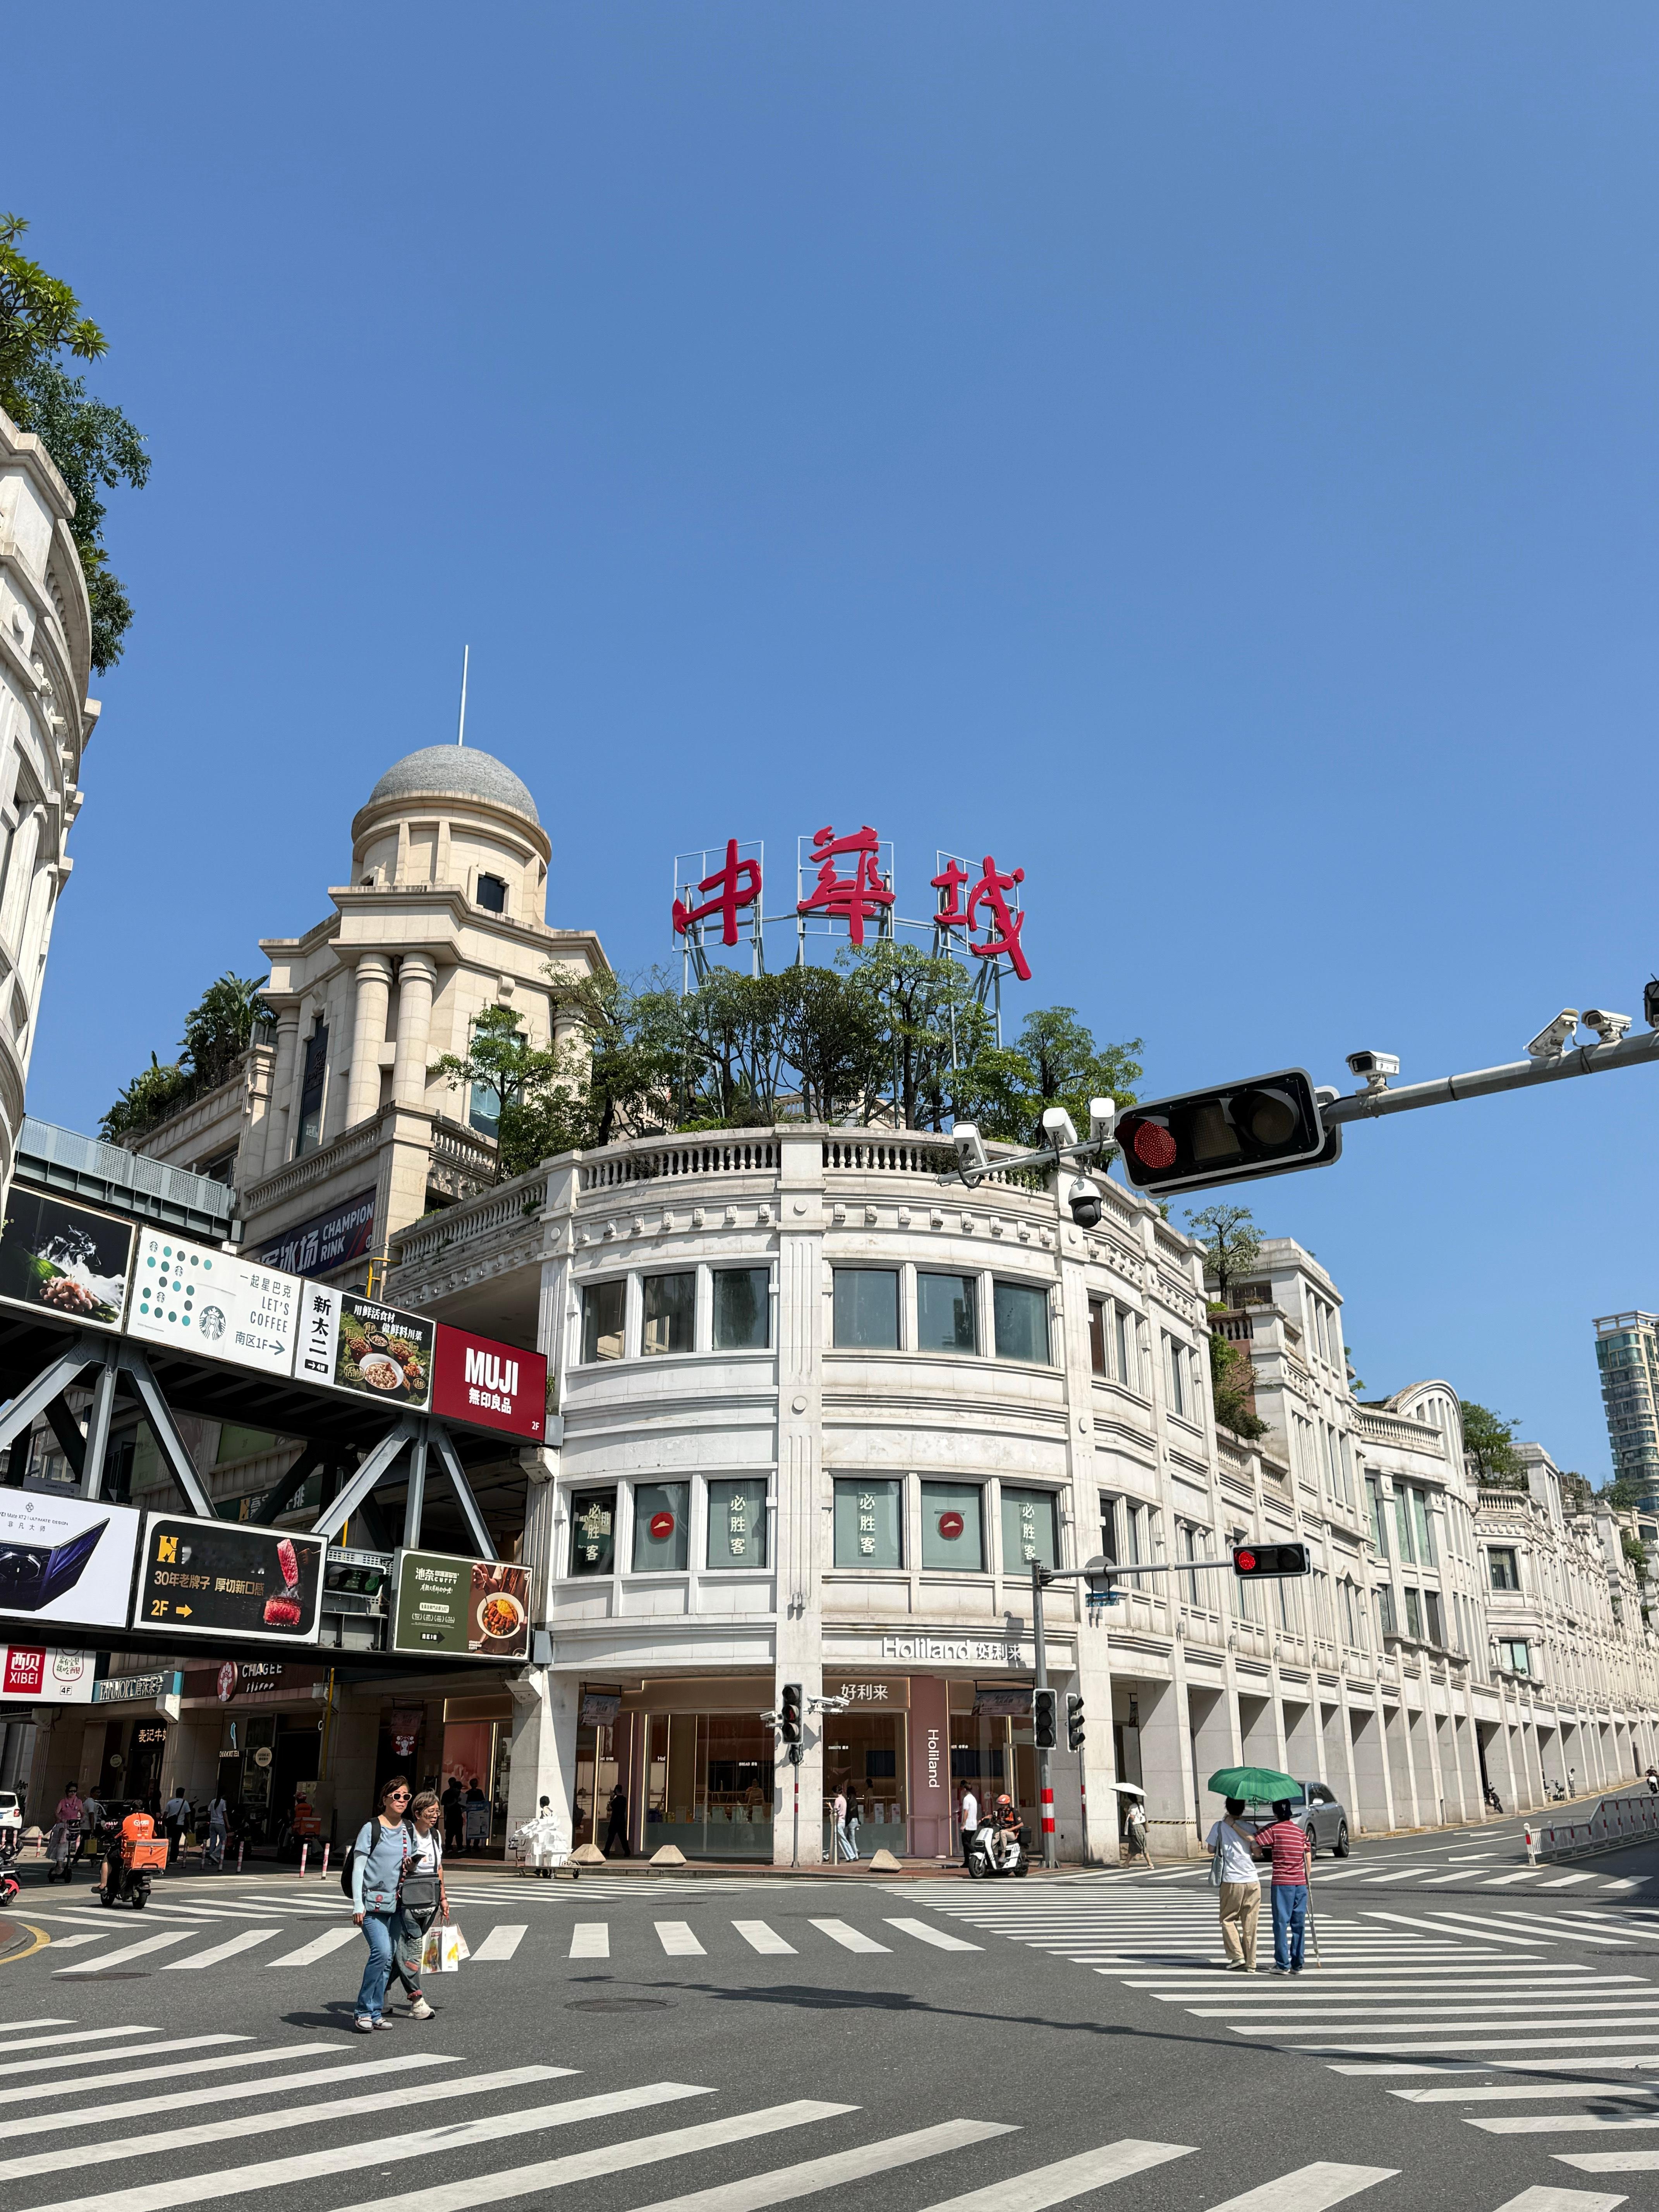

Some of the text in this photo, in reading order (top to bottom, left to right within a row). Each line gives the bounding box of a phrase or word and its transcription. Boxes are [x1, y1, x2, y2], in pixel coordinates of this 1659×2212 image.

[672, 825, 1032, 981] 中華城
[323, 1202, 374, 1241] CHAMPION
[320, 1236, 345, 1262] RINK
[240, 1274, 292, 1298] 一起星巴克
[261, 1296, 289, 1316] LET'S
[250, 1311, 288, 1333] COFFEE
[309, 1295, 331, 1355] 新太二
[235, 1331, 268, 1350] 南区1F
[465, 1347, 519, 1396] MUJI
[469, 1387, 512, 1415] 無印良品
[531, 1421, 540, 1431] 2F
[8, 1521, 46, 1532] 非凡大师
[586, 1503, 601, 1561] 必胜客
[730, 1495, 746, 1554] 必胜客
[859, 1494, 876, 1554] 必胜客
[1022, 1503, 1036, 1561] 必胜客
[154, 1570, 265, 1596] 30年老牌子 厚切新口感
[151, 1599, 169, 1616] 2F
[11, 1652, 40, 1671] 西贝
[883, 1637, 1024, 1661] Holiland 好利来
[9, 1672, 38, 1685] XIBEI
[242, 1663, 282, 1678] CHAGEE
[841, 1684, 888, 1700] 好利来
[927, 1729, 940, 1788] Holiland
